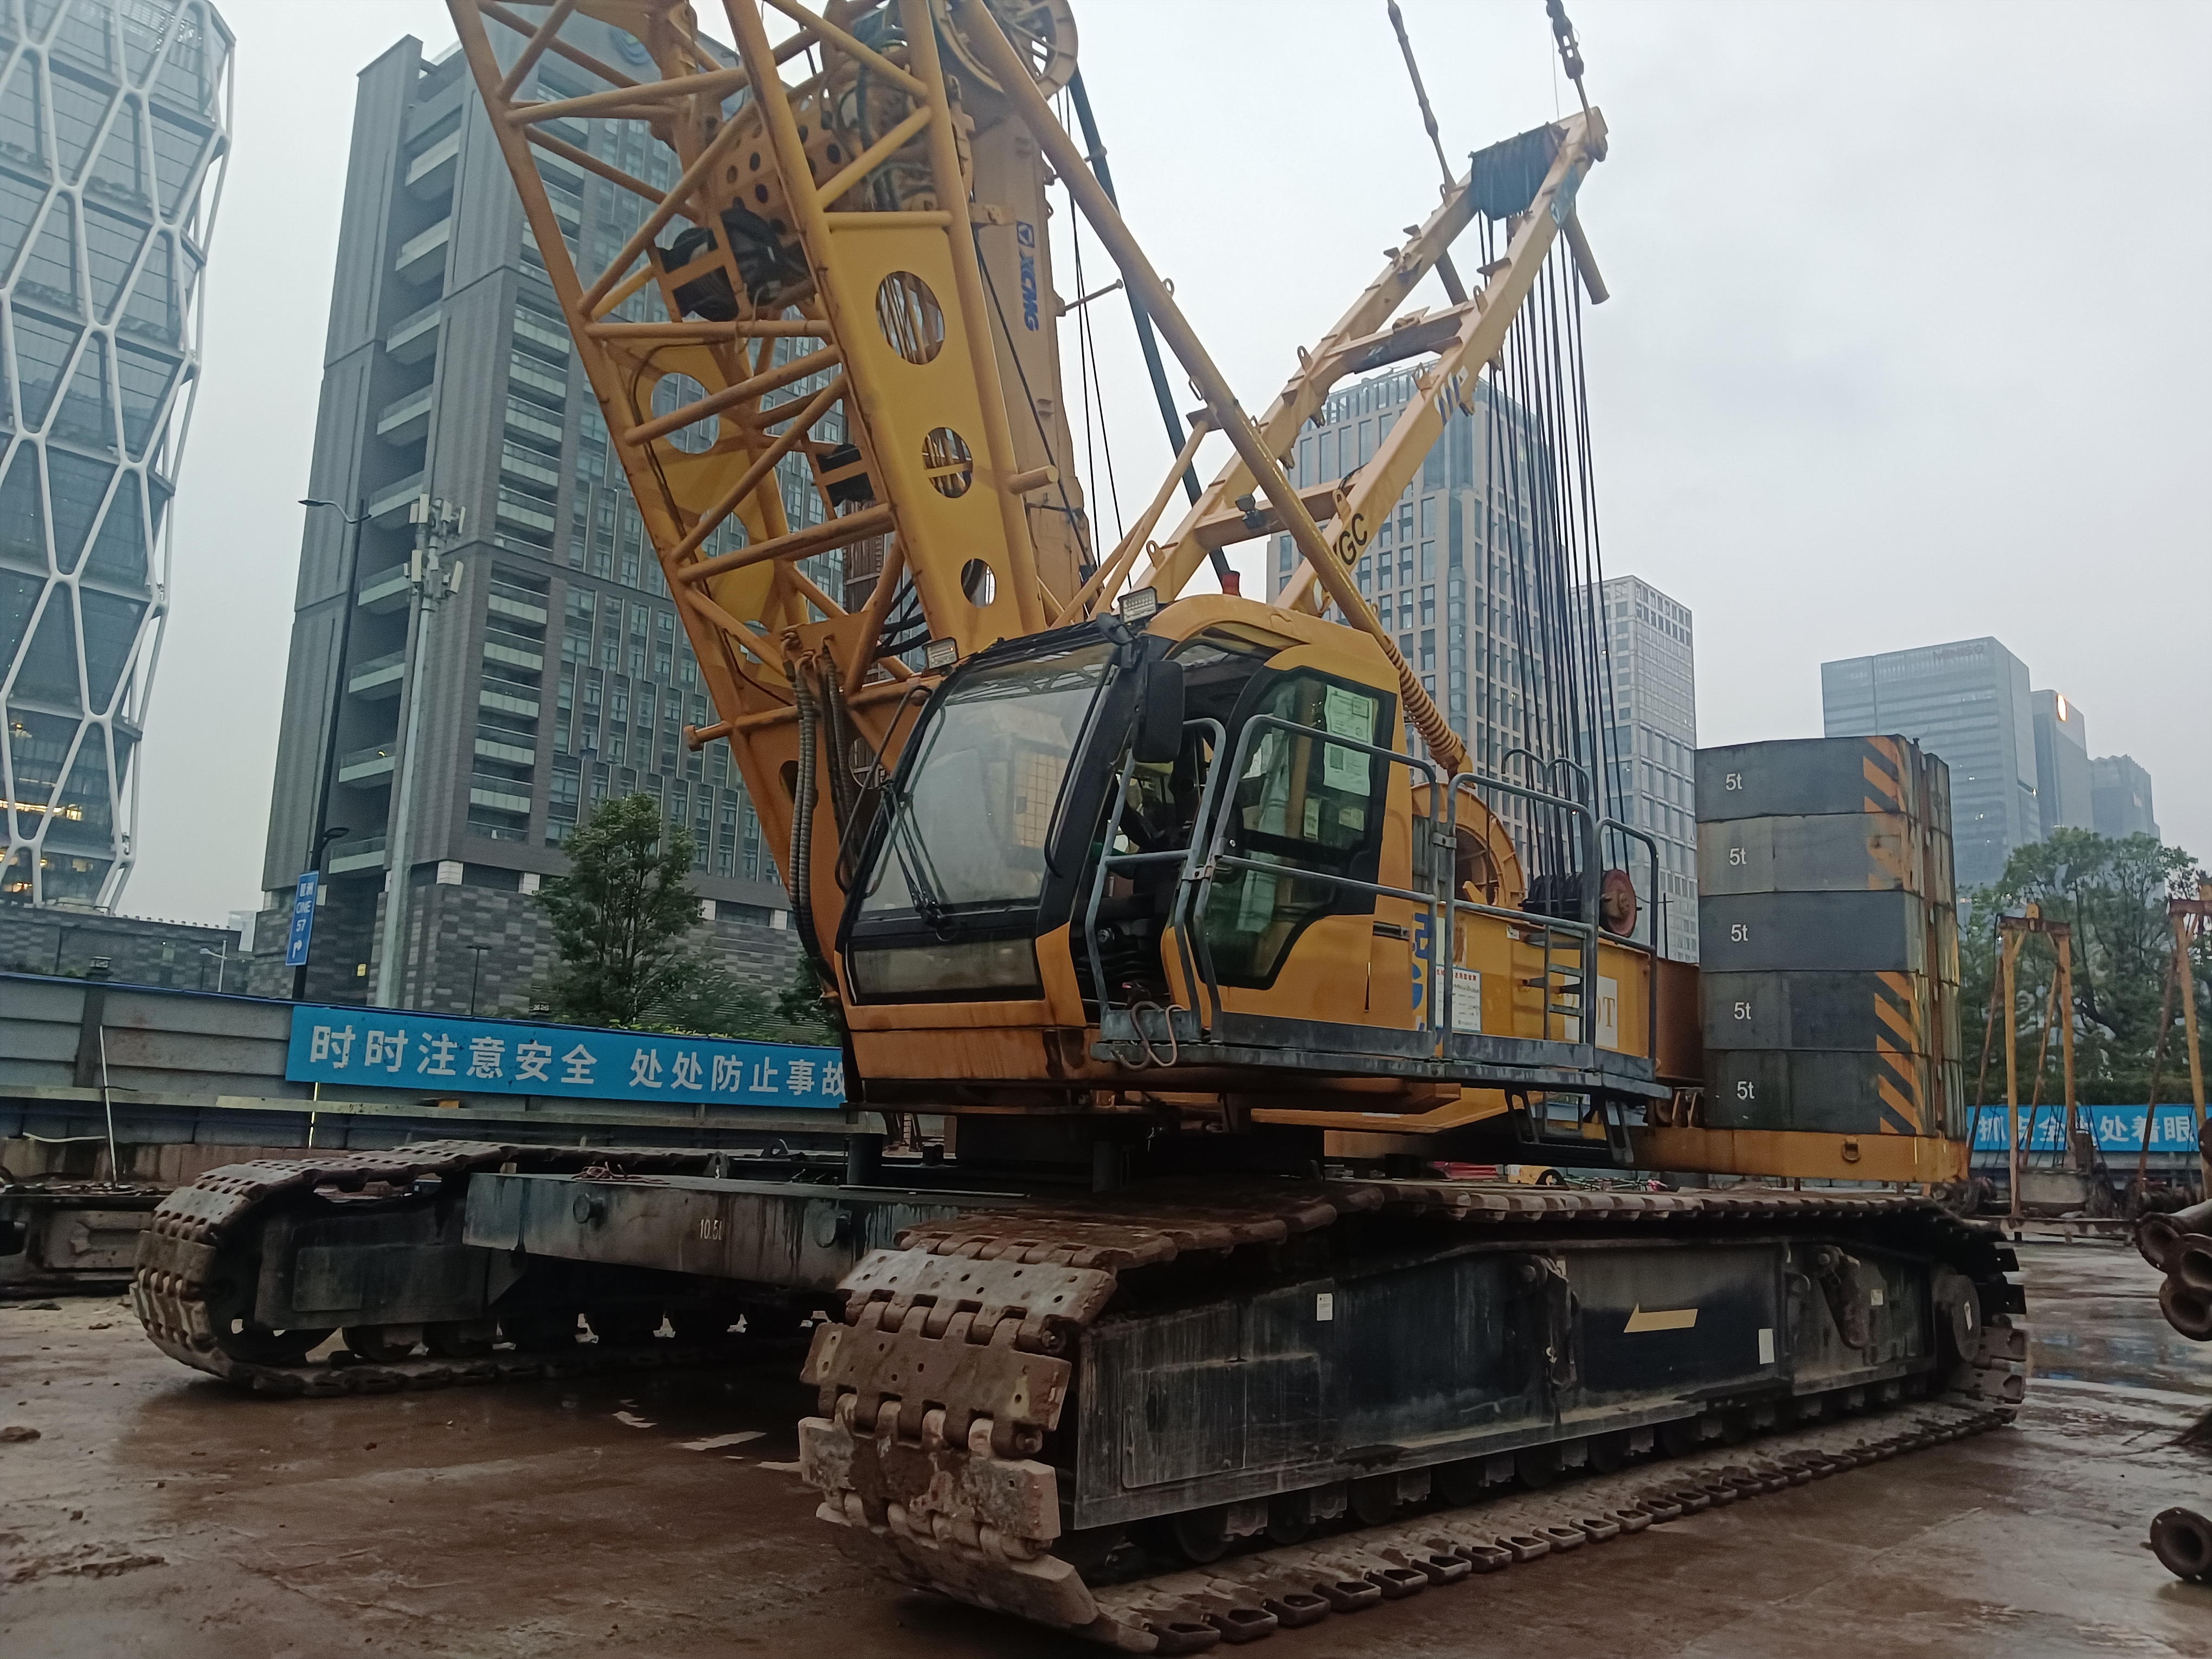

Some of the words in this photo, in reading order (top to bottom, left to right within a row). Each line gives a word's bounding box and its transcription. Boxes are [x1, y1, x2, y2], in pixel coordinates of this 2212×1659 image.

[1019, 246, 1039, 332] XCMG
[1333, 512, 1367, 565] GC
[1725, 773, 1743, 792] 5t
[1728, 847, 1747, 866] 5t
[295, 918, 307, 933] 57
[1730, 923, 1750, 943] 5t
[1733, 1001, 1752, 1021] 5t
[310, 1025, 597, 1085] 时时注意安全
[628, 1048, 846, 1097] 处处防止事故
[1736, 1081, 1755, 1100] 5t
